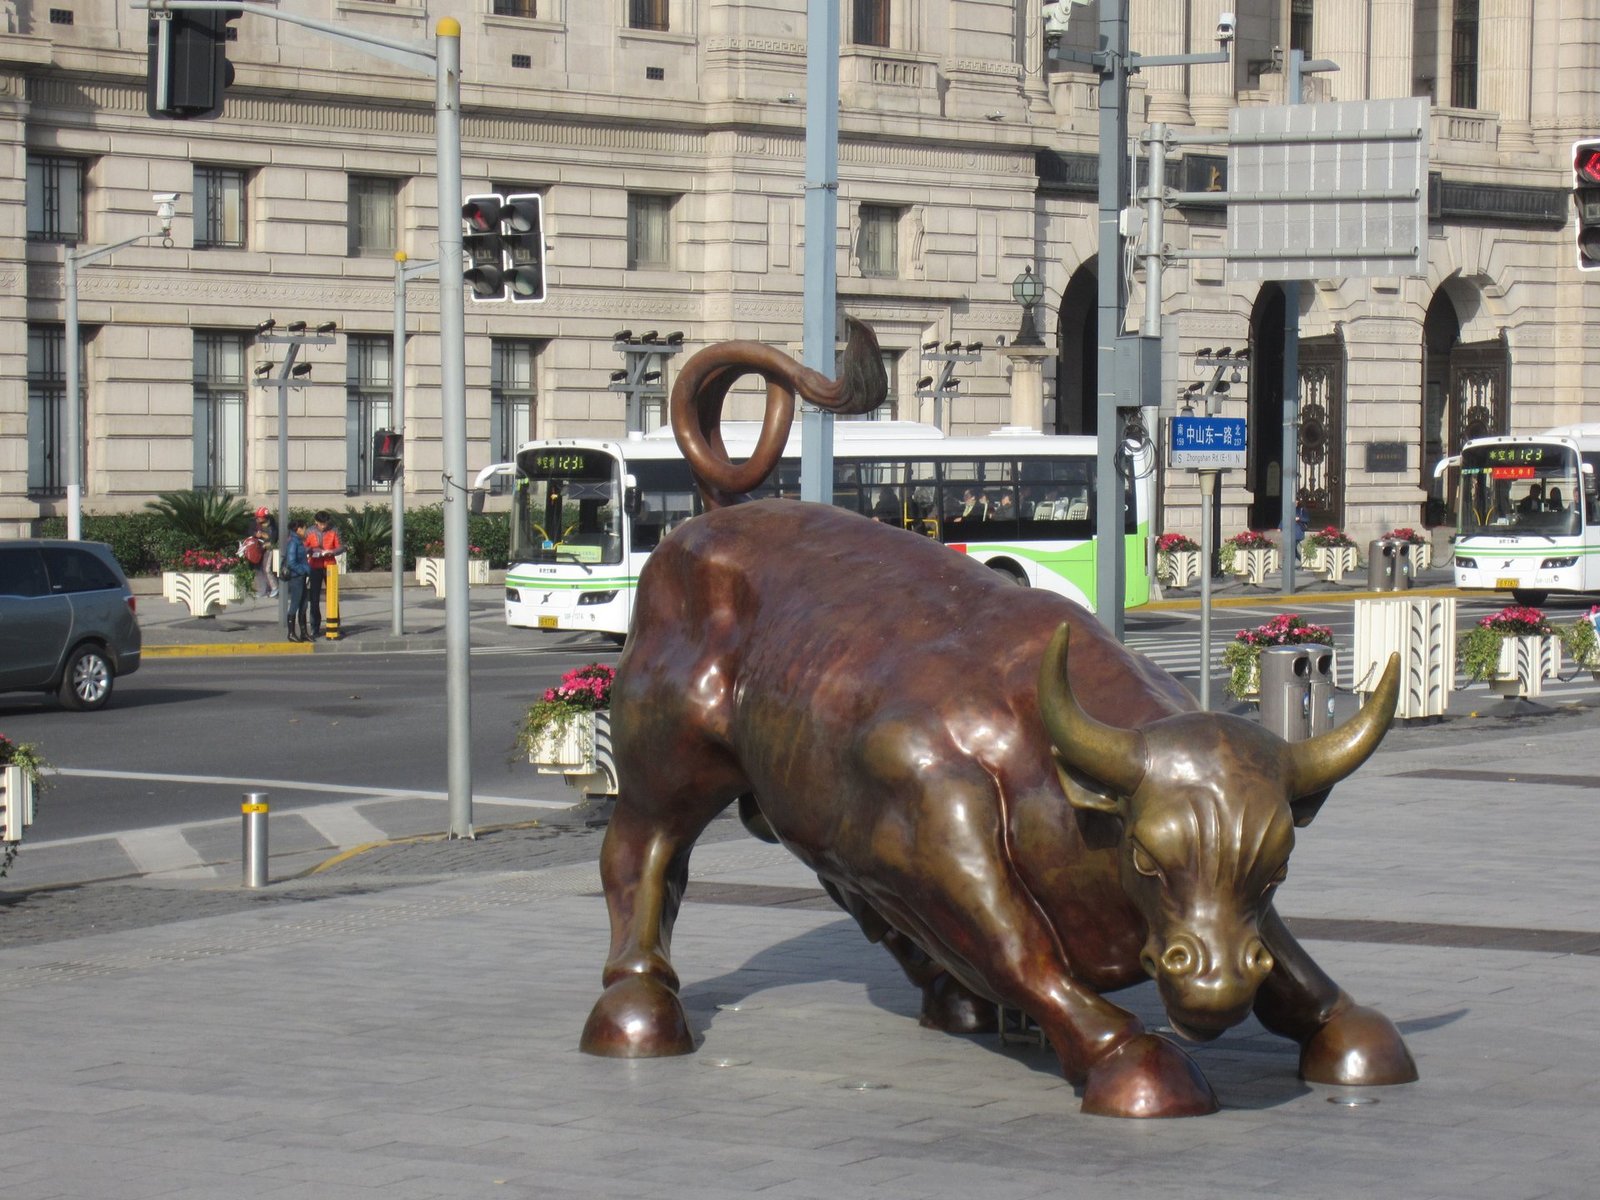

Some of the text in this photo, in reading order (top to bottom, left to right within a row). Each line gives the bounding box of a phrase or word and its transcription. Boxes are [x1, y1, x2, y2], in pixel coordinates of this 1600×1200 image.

[1187, 425, 1232, 445] 中山东一路
[1235, 424, 1241, 436] 北
[1177, 453, 1182, 463] S
[1186, 453, 1211, 464] Zhongshan
[1236, 454, 1240, 463] N
[1520, 449, 1543, 461] 123
[558, 456, 578, 470] 123
